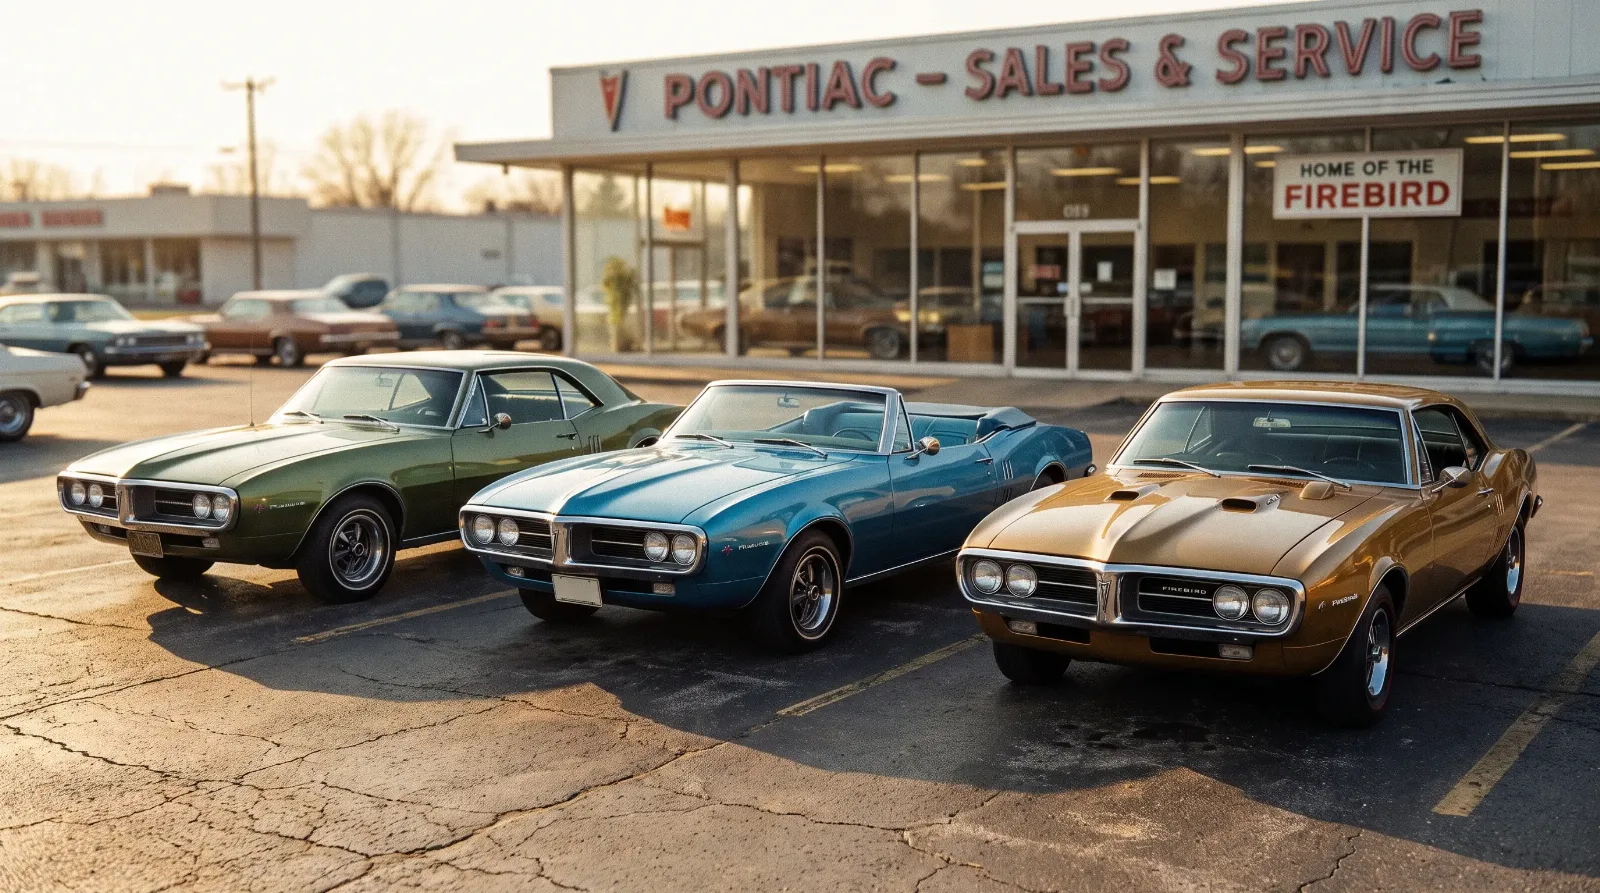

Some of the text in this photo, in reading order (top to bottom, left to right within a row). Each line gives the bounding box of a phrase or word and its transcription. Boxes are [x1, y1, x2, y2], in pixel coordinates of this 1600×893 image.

[664, 57, 896, 120] PONTIAC
[965, 37, 1130, 100] SALES
[1155, 33, 1191, 88] &
[1216, 9, 1483, 84] SERVICE
[1301, 159, 1434, 177] HOME OF THE
[1284, 180, 1451, 209] FIREBIRD
[1162, 586, 1207, 595] FIREBIRD
